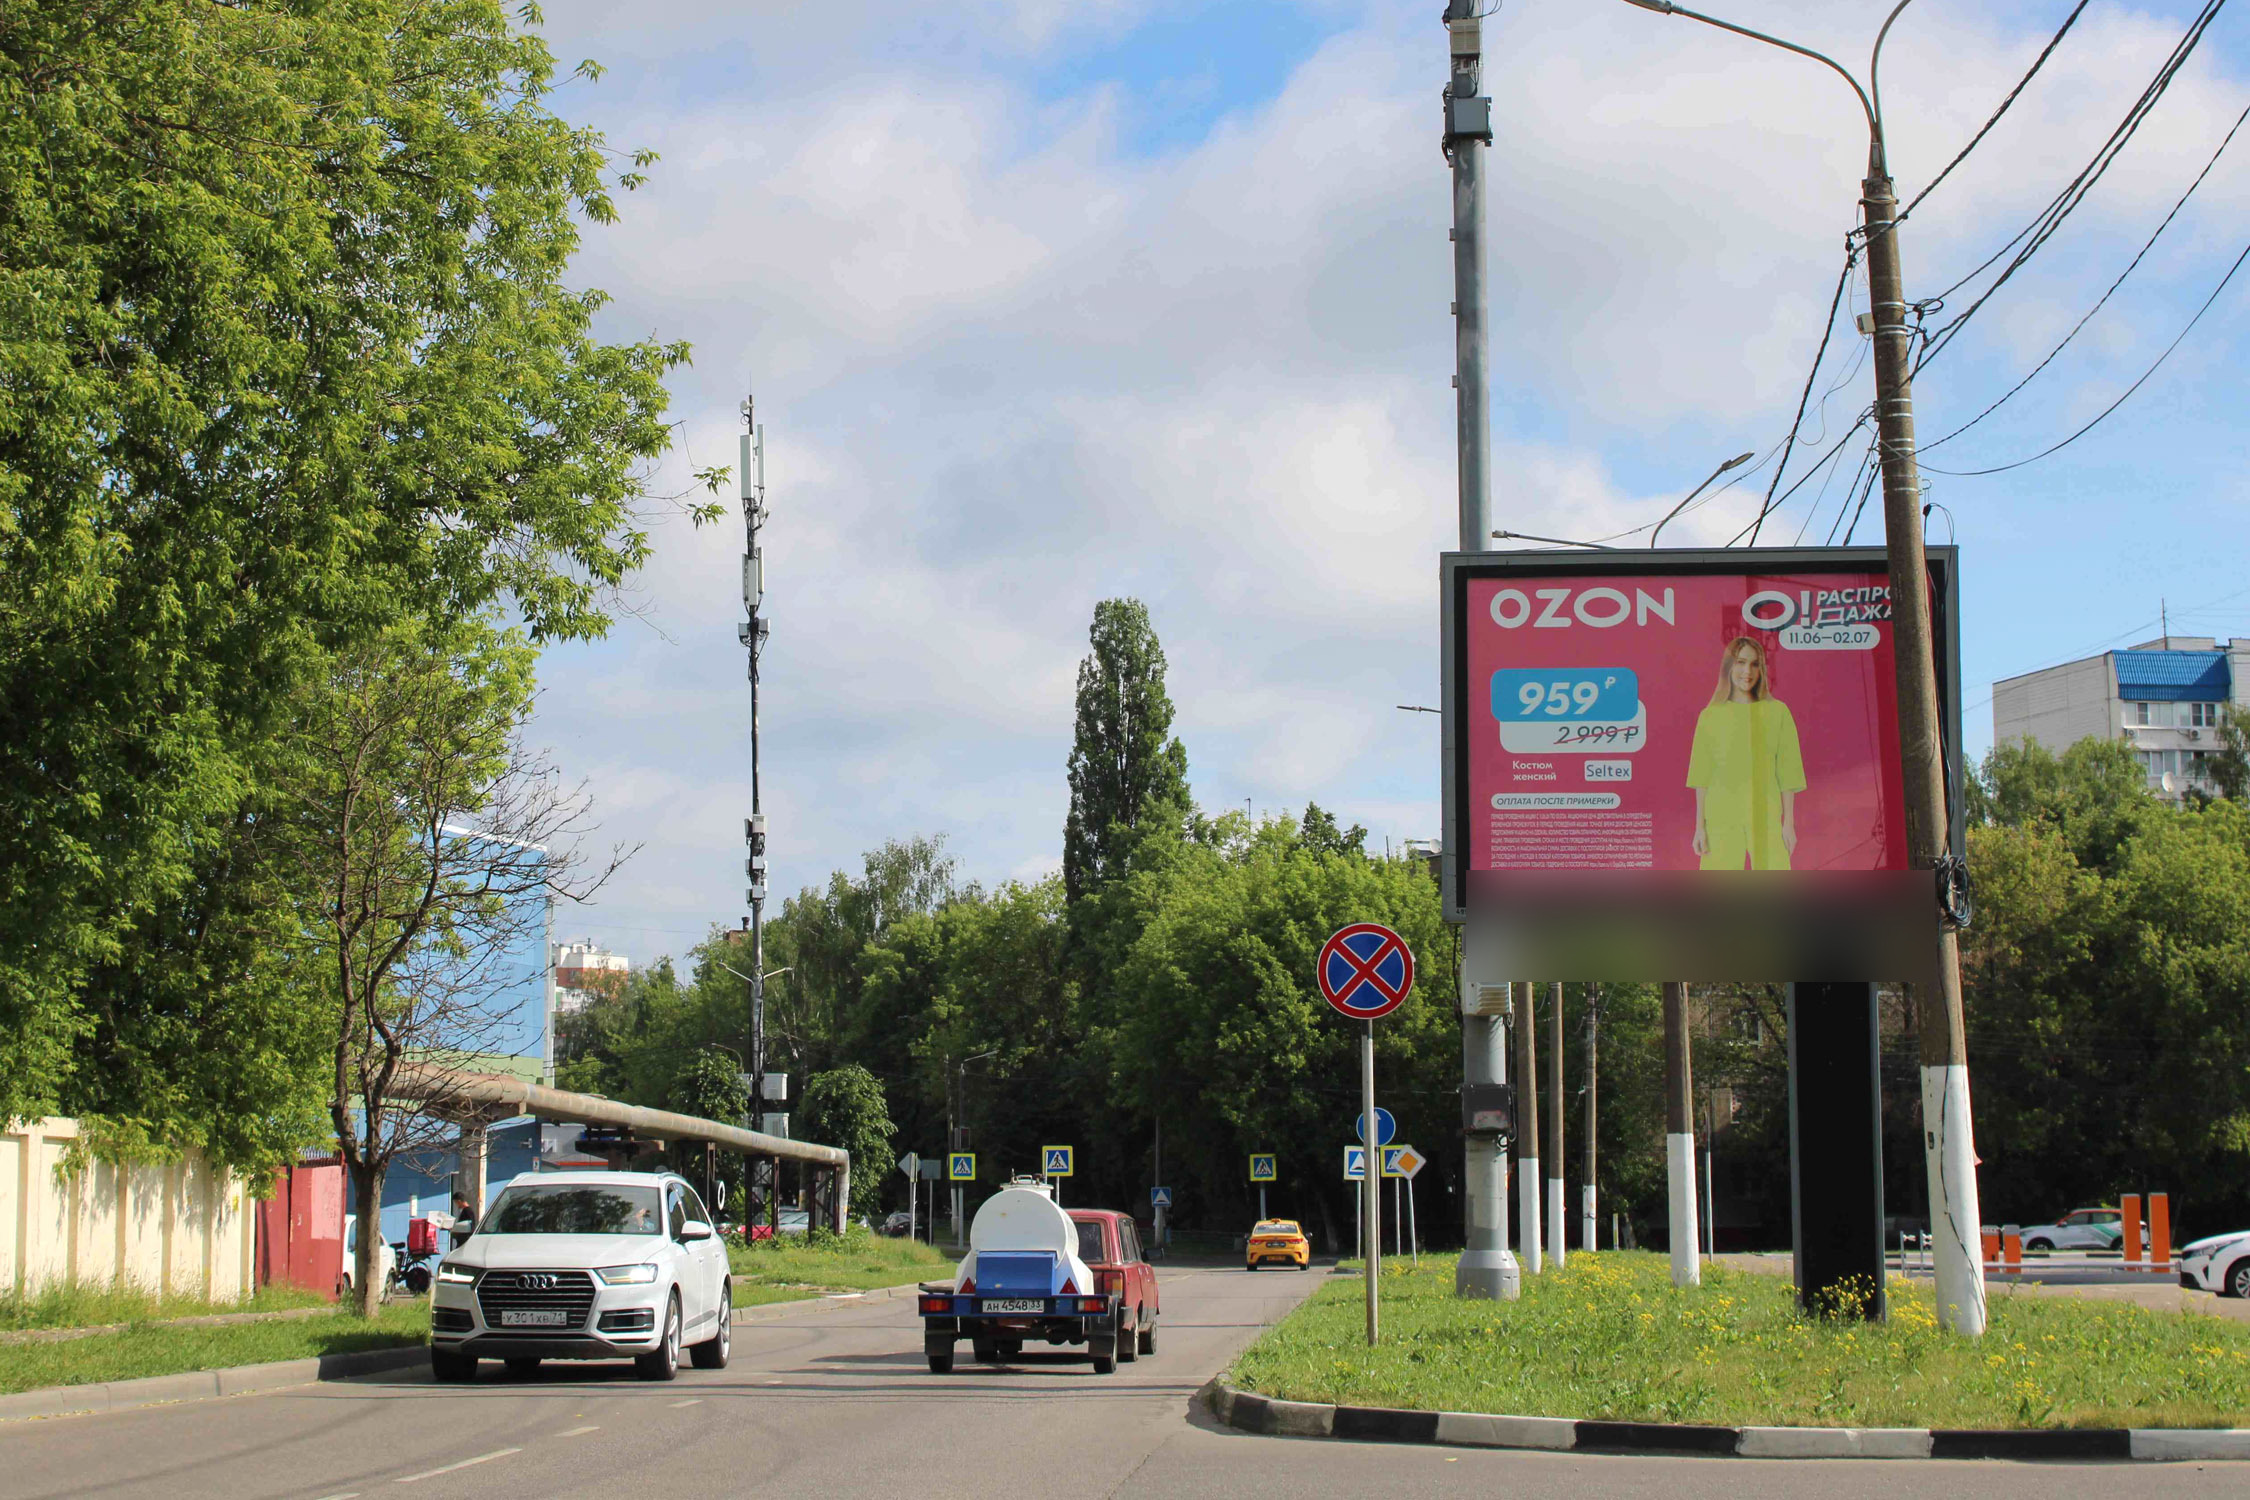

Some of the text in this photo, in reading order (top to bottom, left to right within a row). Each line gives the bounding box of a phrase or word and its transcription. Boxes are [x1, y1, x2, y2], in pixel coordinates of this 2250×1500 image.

[1490, 587, 1675, 628] OZON
[1518, 681, 1599, 716] 959
[1512, 760, 1553, 771] Костюм
[1586, 764, 1630, 778] Seltex
[1512, 772, 1557, 782] женский
[1496, 796, 1615, 806] ОПЛАТА ПОСЛЕ ПРИМЕРКИ
